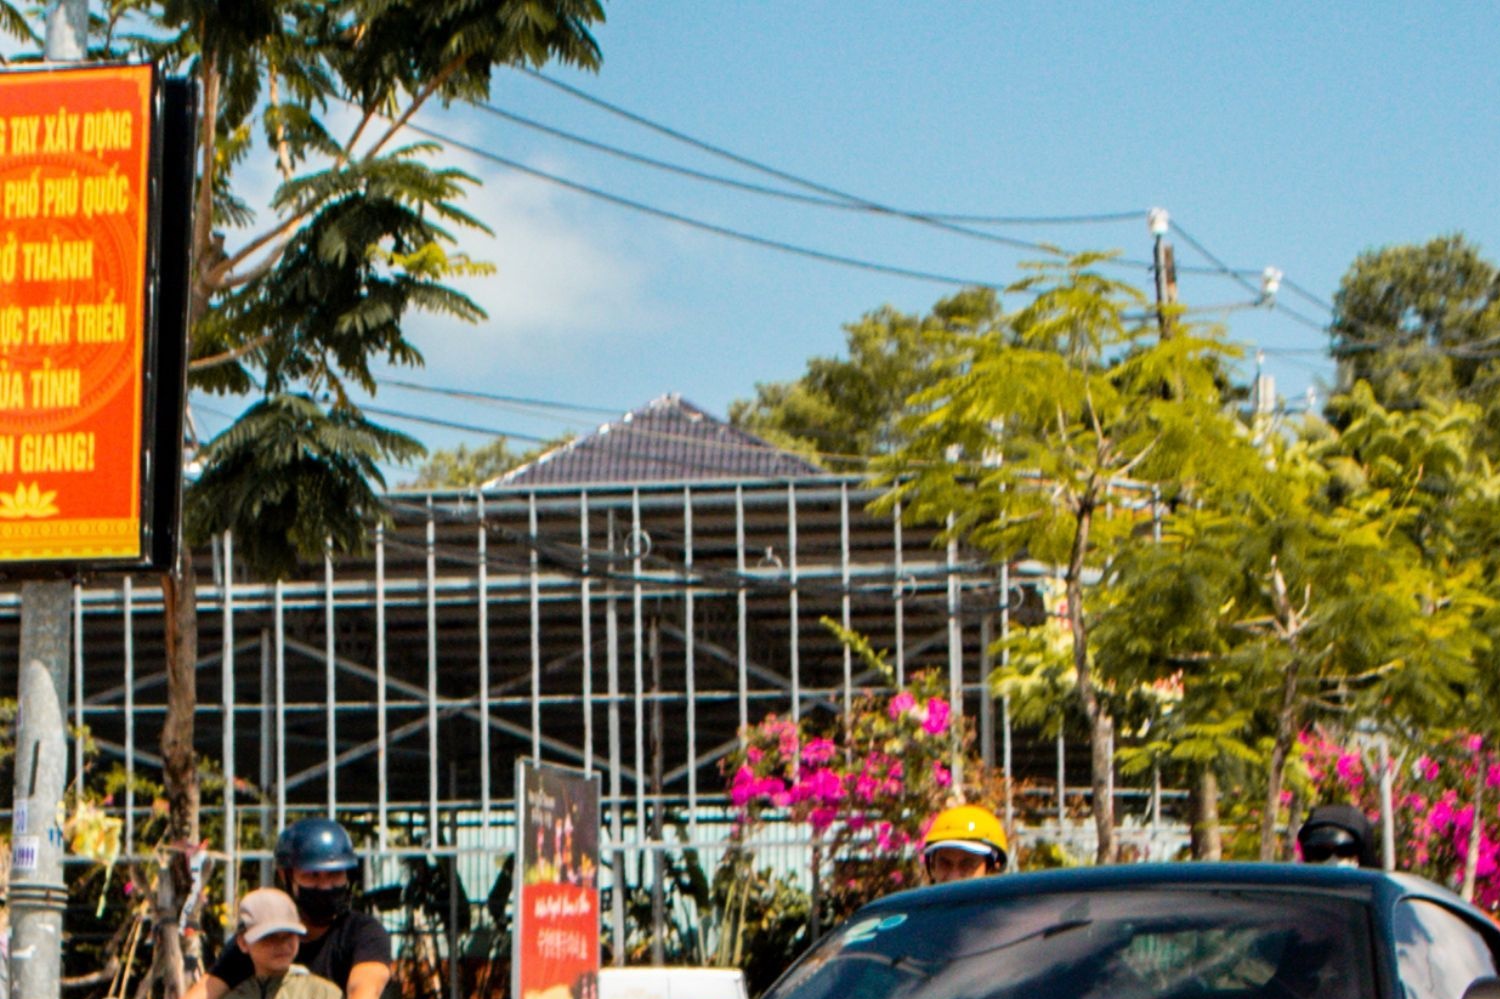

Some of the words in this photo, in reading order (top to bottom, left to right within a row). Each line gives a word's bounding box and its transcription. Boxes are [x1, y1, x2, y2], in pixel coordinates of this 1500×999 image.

[10, 115, 39, 155] TAY
[43, 106, 79, 154] XÂY
[83, 108, 131, 159] DỰNG
[4, 166, 40, 219] PHỐ
[43, 169, 78, 218] PHÚ
[83, 162, 128, 219] QUỐC
[22, 234, 93, 281] THÀNH
[28, 298, 71, 344] PHÁT
[76, 288, 126, 343] TRIỂN
[21, 431, 95, 473] GIANG!
